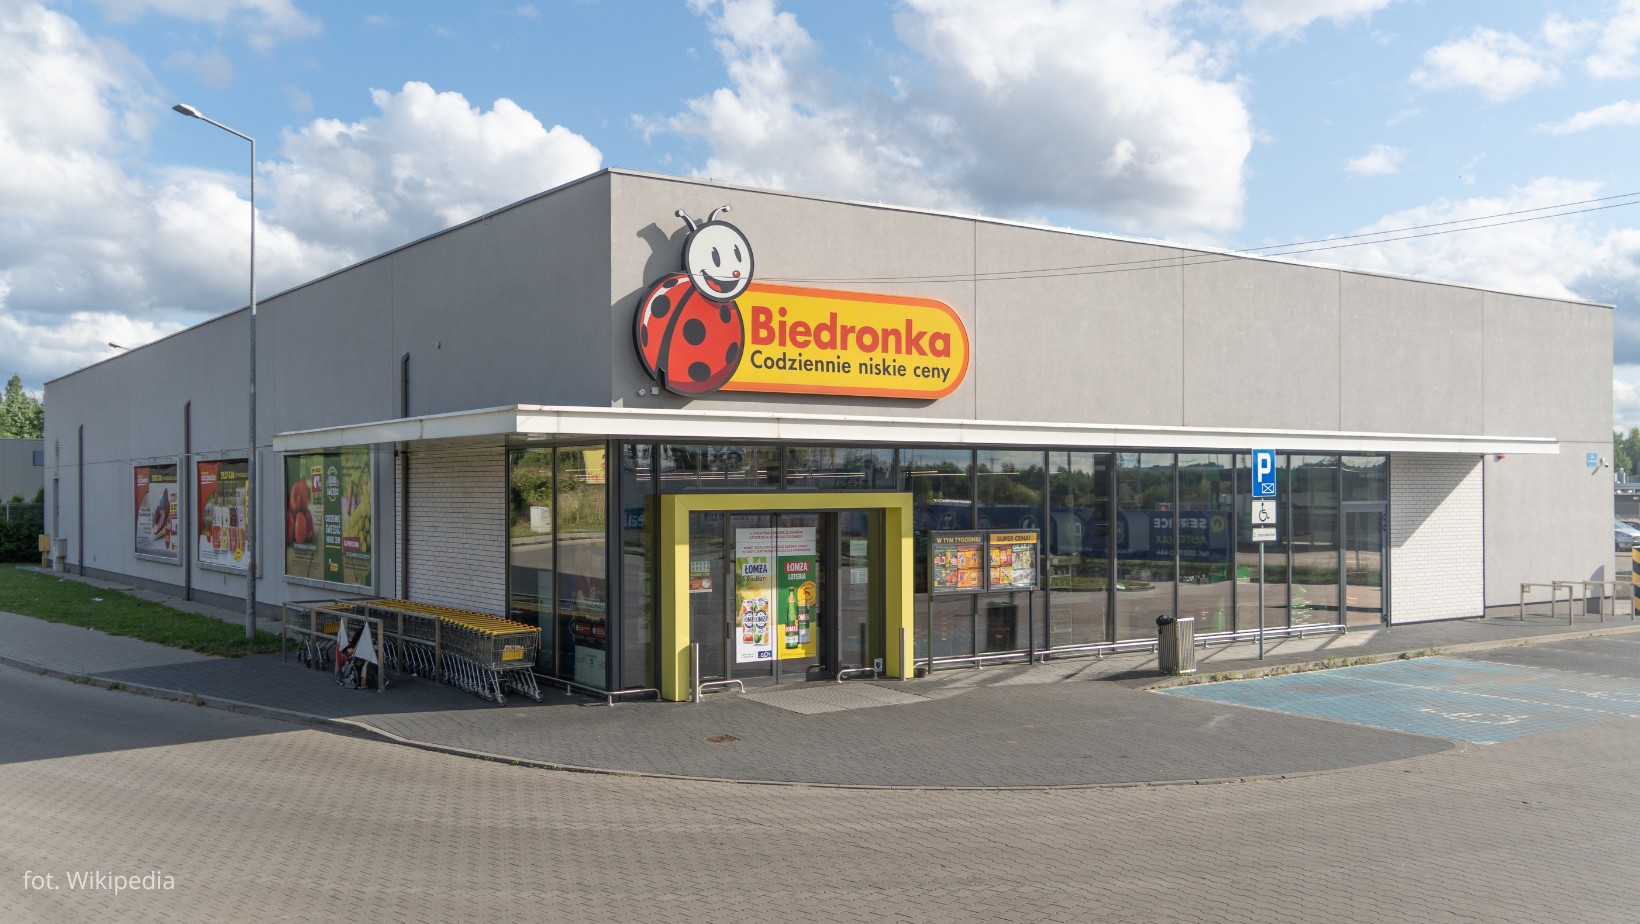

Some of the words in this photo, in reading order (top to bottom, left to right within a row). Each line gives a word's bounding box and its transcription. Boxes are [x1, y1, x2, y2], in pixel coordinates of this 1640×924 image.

[751, 305, 951, 358] Biedronka
[750, 349, 851, 374] Codziennie
[858, 357, 907, 378] niskie
[913, 365, 951, 383] ceny
[1257, 452, 1271, 483] P
[744, 564, 768, 575] ŁOMŻA
[786, 562, 808, 572] ŁOMŻA
